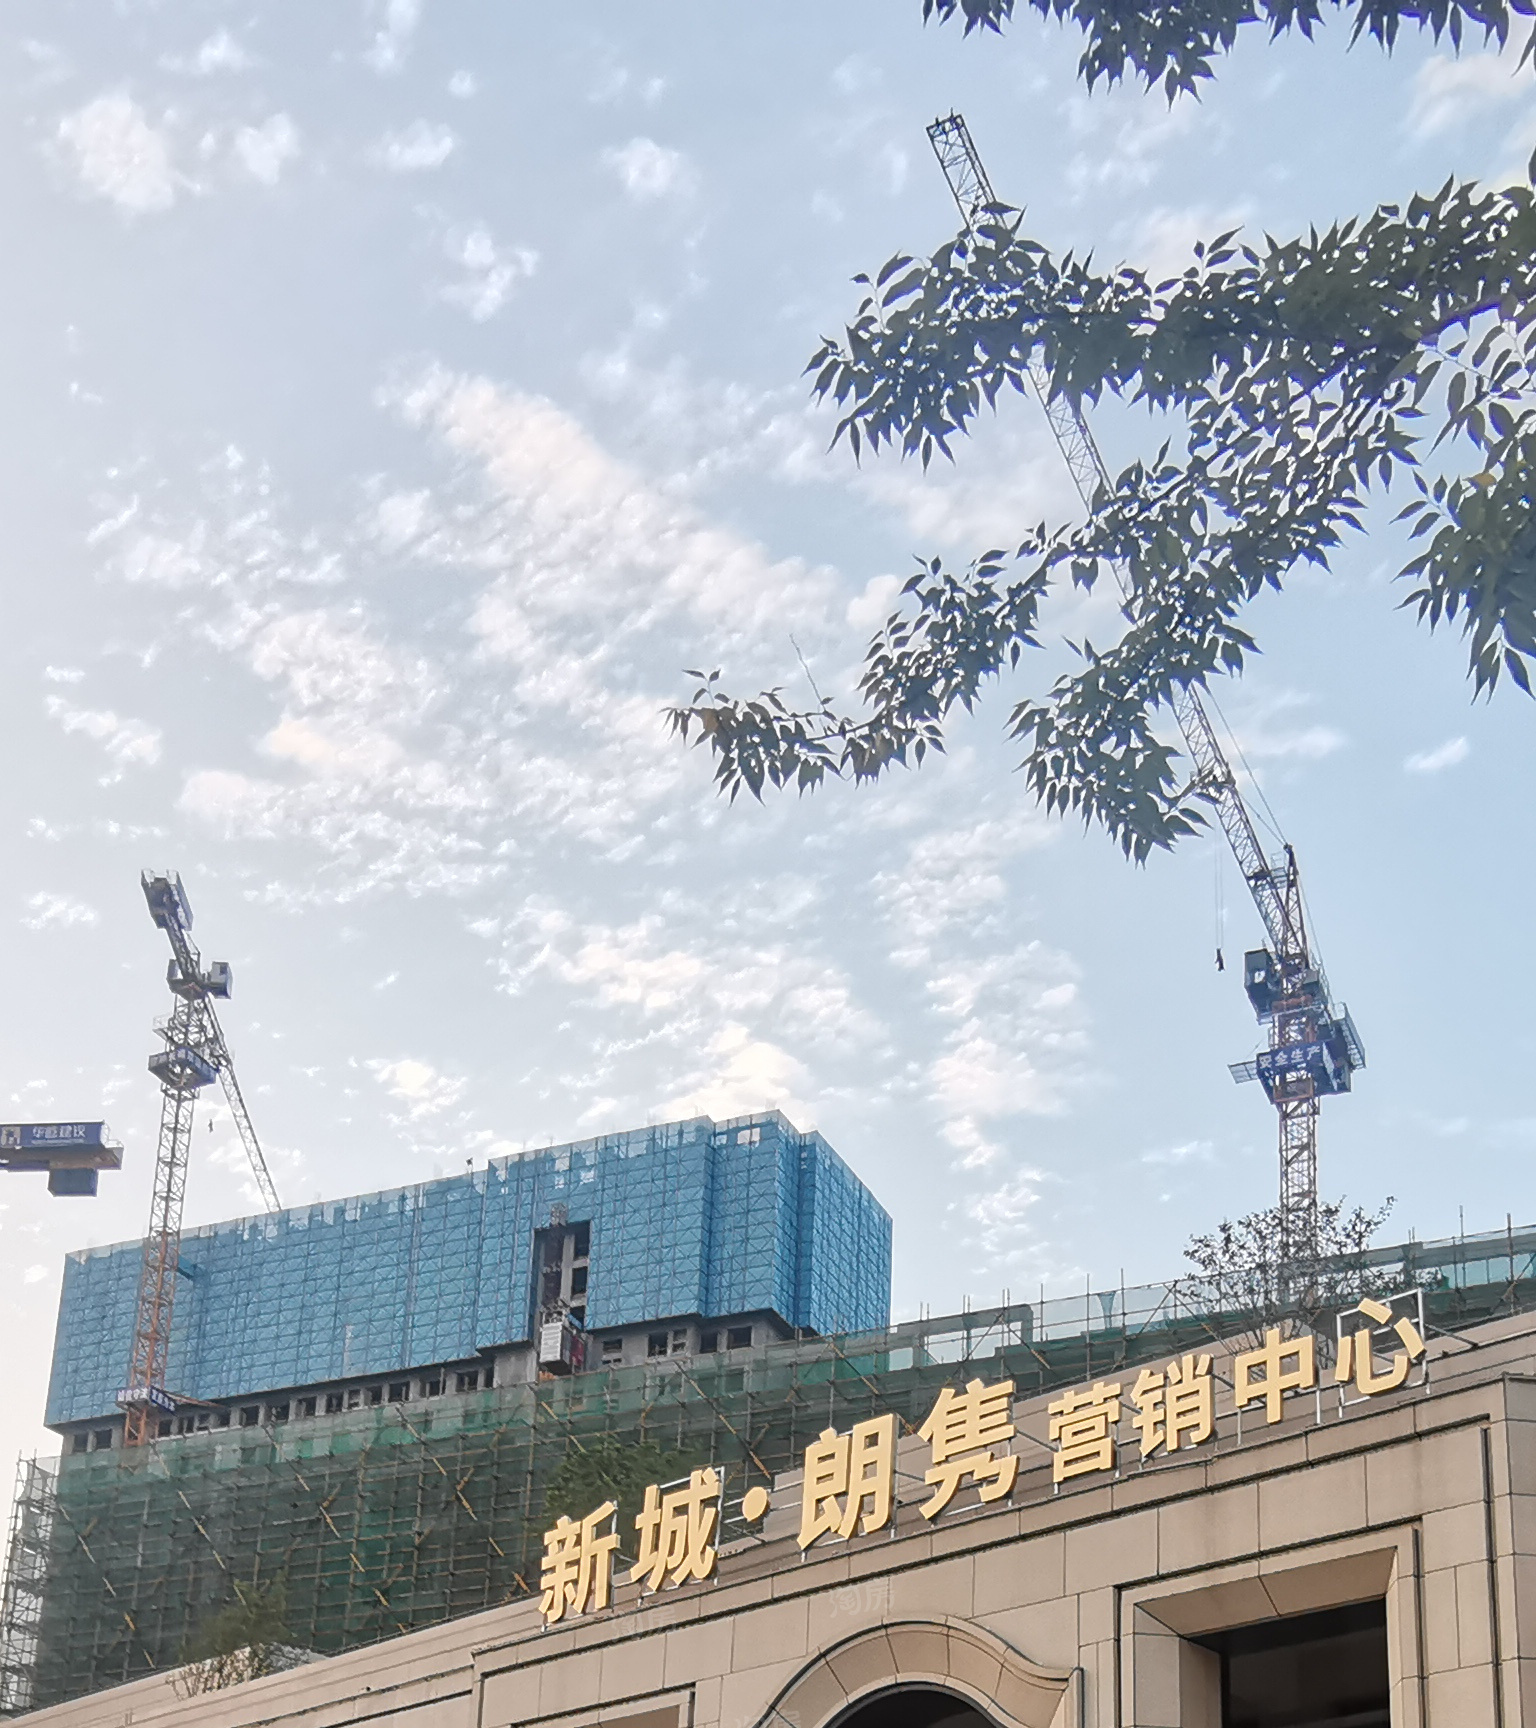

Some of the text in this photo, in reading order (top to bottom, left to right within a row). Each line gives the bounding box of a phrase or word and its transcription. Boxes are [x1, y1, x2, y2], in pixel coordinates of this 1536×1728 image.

[1259, 1045, 1321, 1069] 安全生产
[538, 1297, 1424, 1622] 新城·朗隽营销中心
